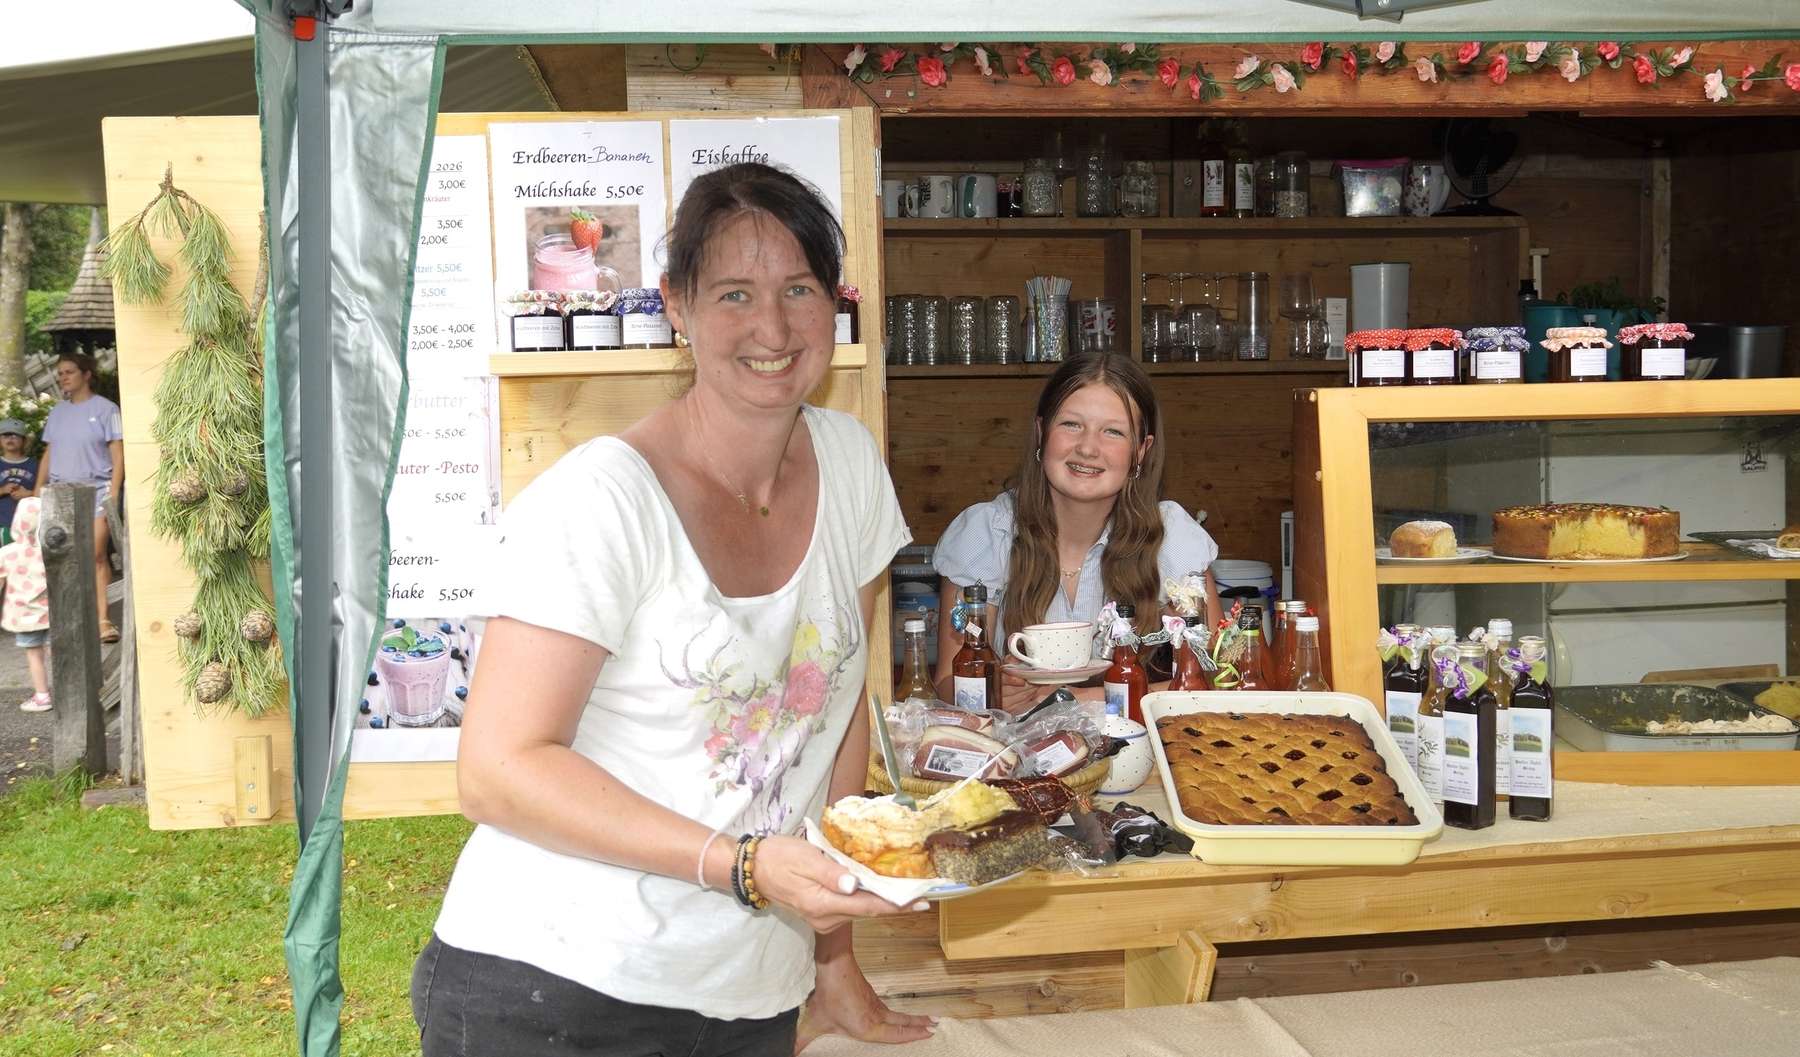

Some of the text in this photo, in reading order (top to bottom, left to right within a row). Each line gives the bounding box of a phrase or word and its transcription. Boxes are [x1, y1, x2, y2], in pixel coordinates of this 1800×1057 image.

[512, 145, 654, 164] Erdbeeren- Bananen
[691, 145, 769, 164] Eiskaffee
[436, 161, 463, 171] 2026
[438, 180, 467, 190] 3,00€
[514, 180, 645, 199] Milchshake 5,50€
[437, 219, 464, 230] 3,50€
[420, 235, 449, 246] 2,00€
[436, 263, 463, 273] 5,50€
[421, 287, 447, 297] 5,50€
[412, 325, 439, 336] 3,50€
[448, 323, 476, 334] 4,00€
[411, 340, 439, 351] 2,00€
[447, 339, 474, 349] 2,50€
[435, 428, 467, 440] 5,50€
[434, 492, 467, 504] 5,50€
[388, 549, 440, 566] beeren-
[439, 588, 475, 601] 5,50€
